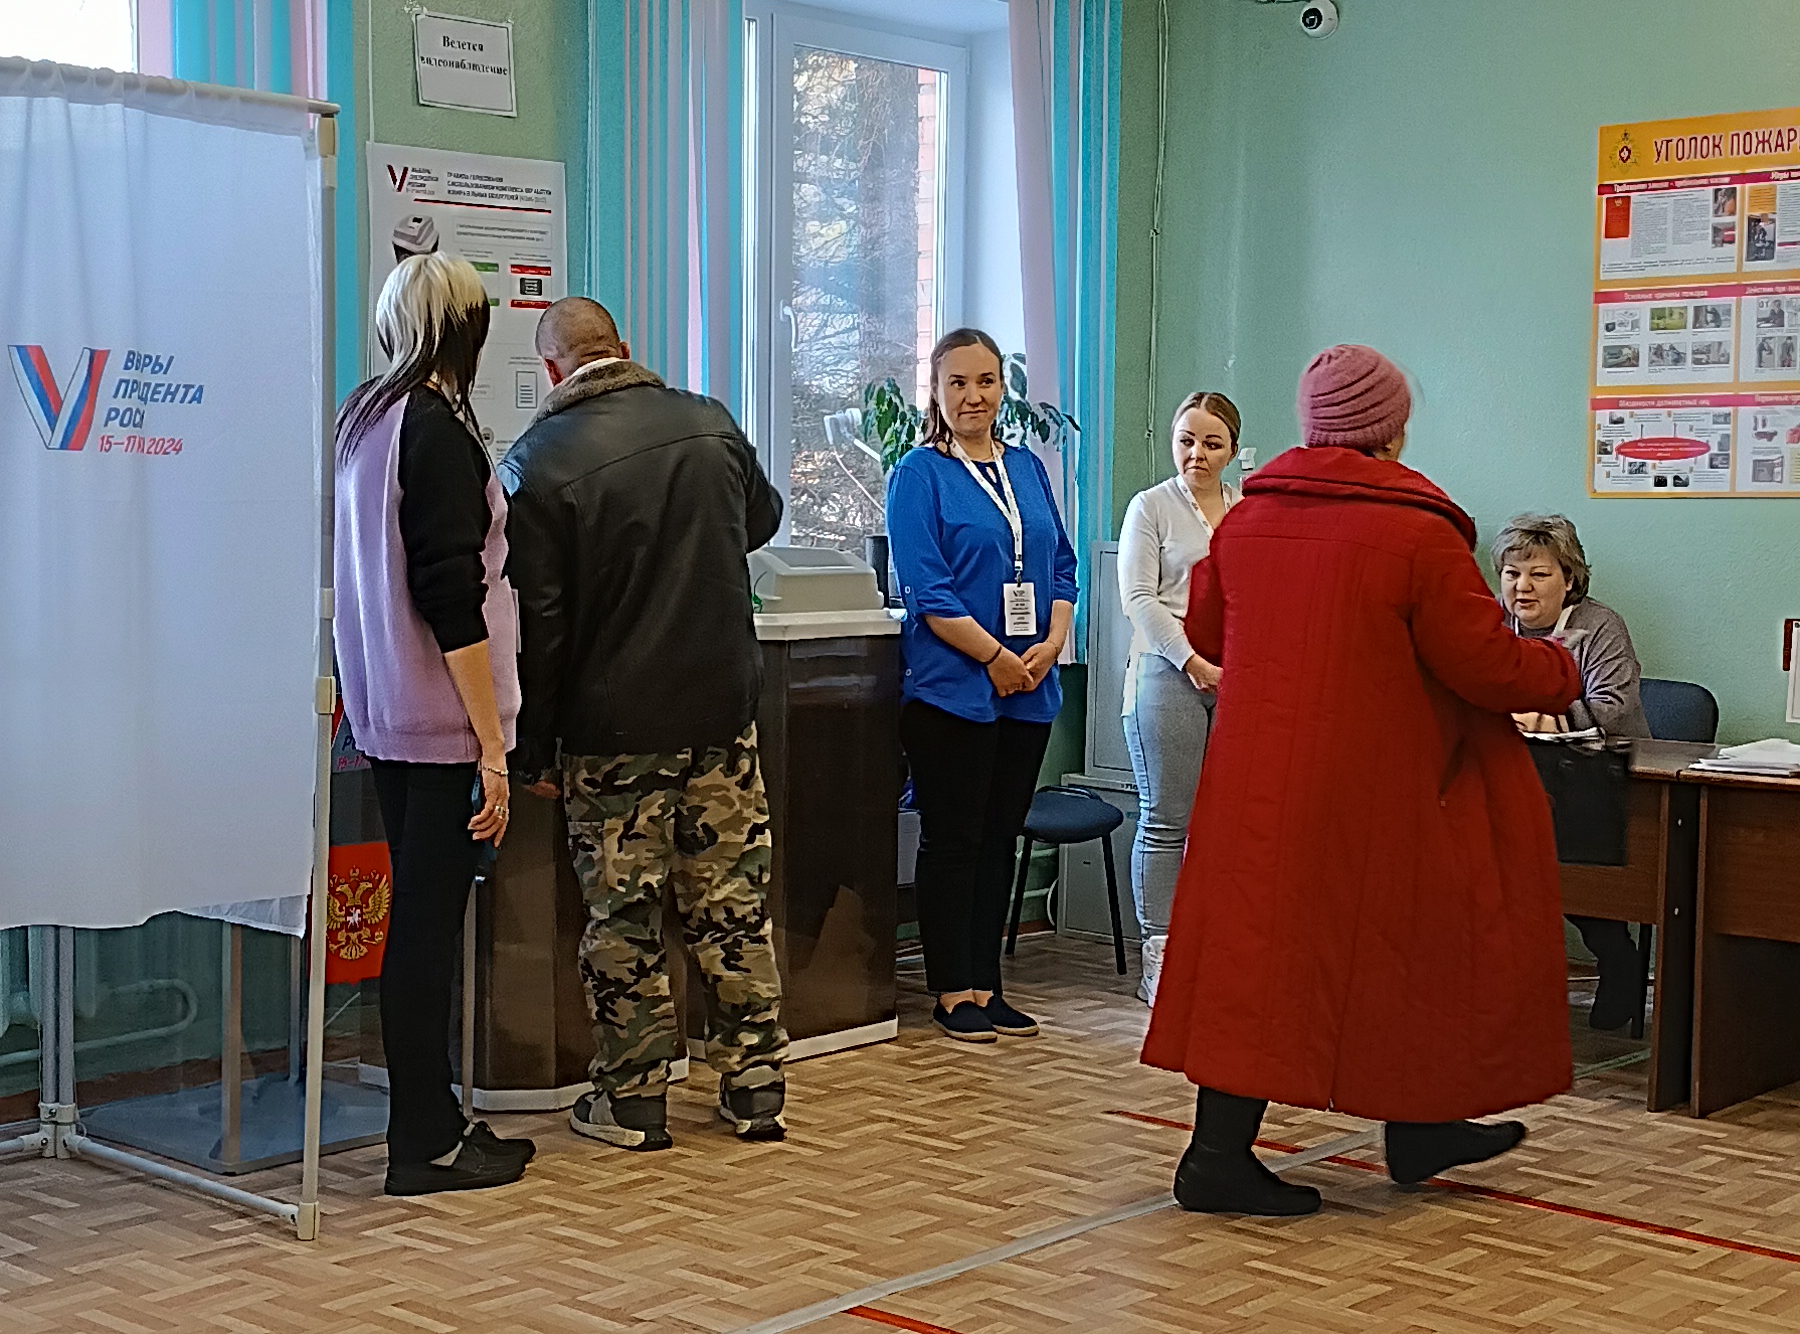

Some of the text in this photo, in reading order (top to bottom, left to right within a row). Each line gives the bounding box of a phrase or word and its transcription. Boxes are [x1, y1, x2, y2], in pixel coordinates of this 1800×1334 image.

[420, 56, 508, 76] видеонаблюдение
[1654, 128, 1800, 163] УГОЛОК ПОЖАР
